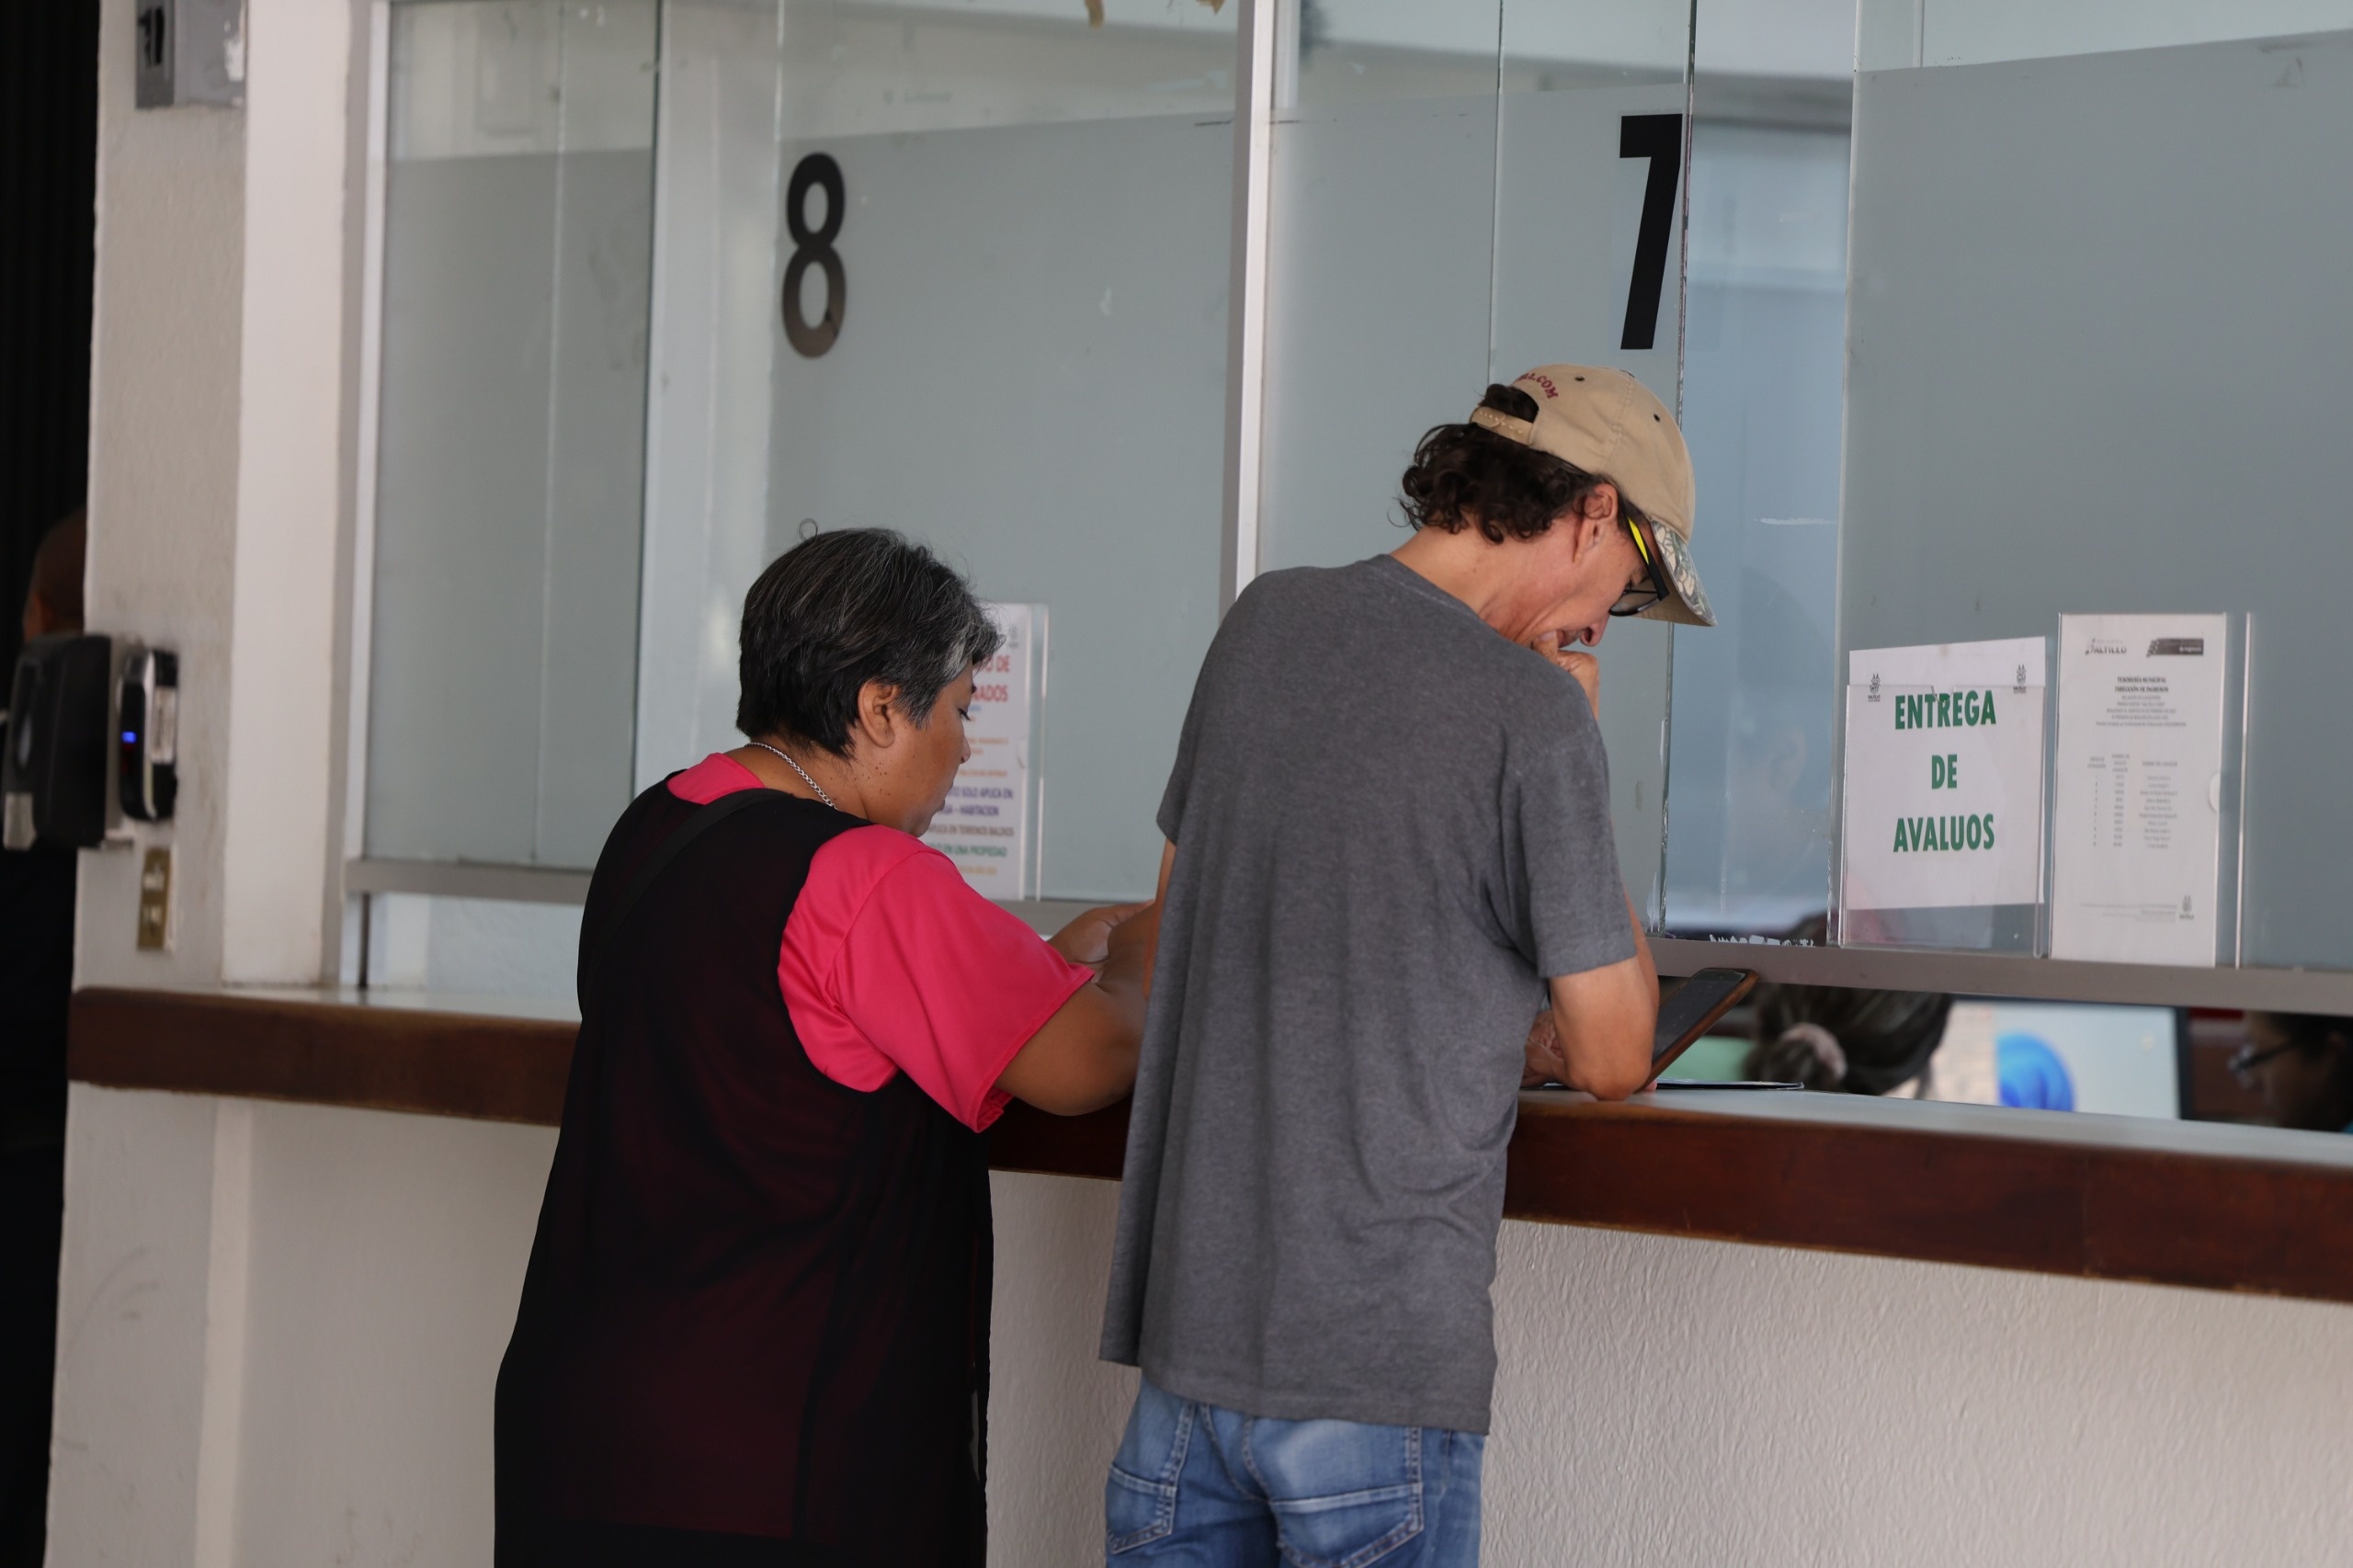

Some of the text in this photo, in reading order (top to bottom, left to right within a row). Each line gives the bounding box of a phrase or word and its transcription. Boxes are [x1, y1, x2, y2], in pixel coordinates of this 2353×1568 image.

[1620, 114, 1683, 350] 7
[782, 151, 847, 359] 8
[996, 653, 1010, 672] DE
[1894, 689, 1996, 730] ENTREGA
[1931, 754, 1958, 790] DE
[1893, 813, 1995, 852] AVALUOS
